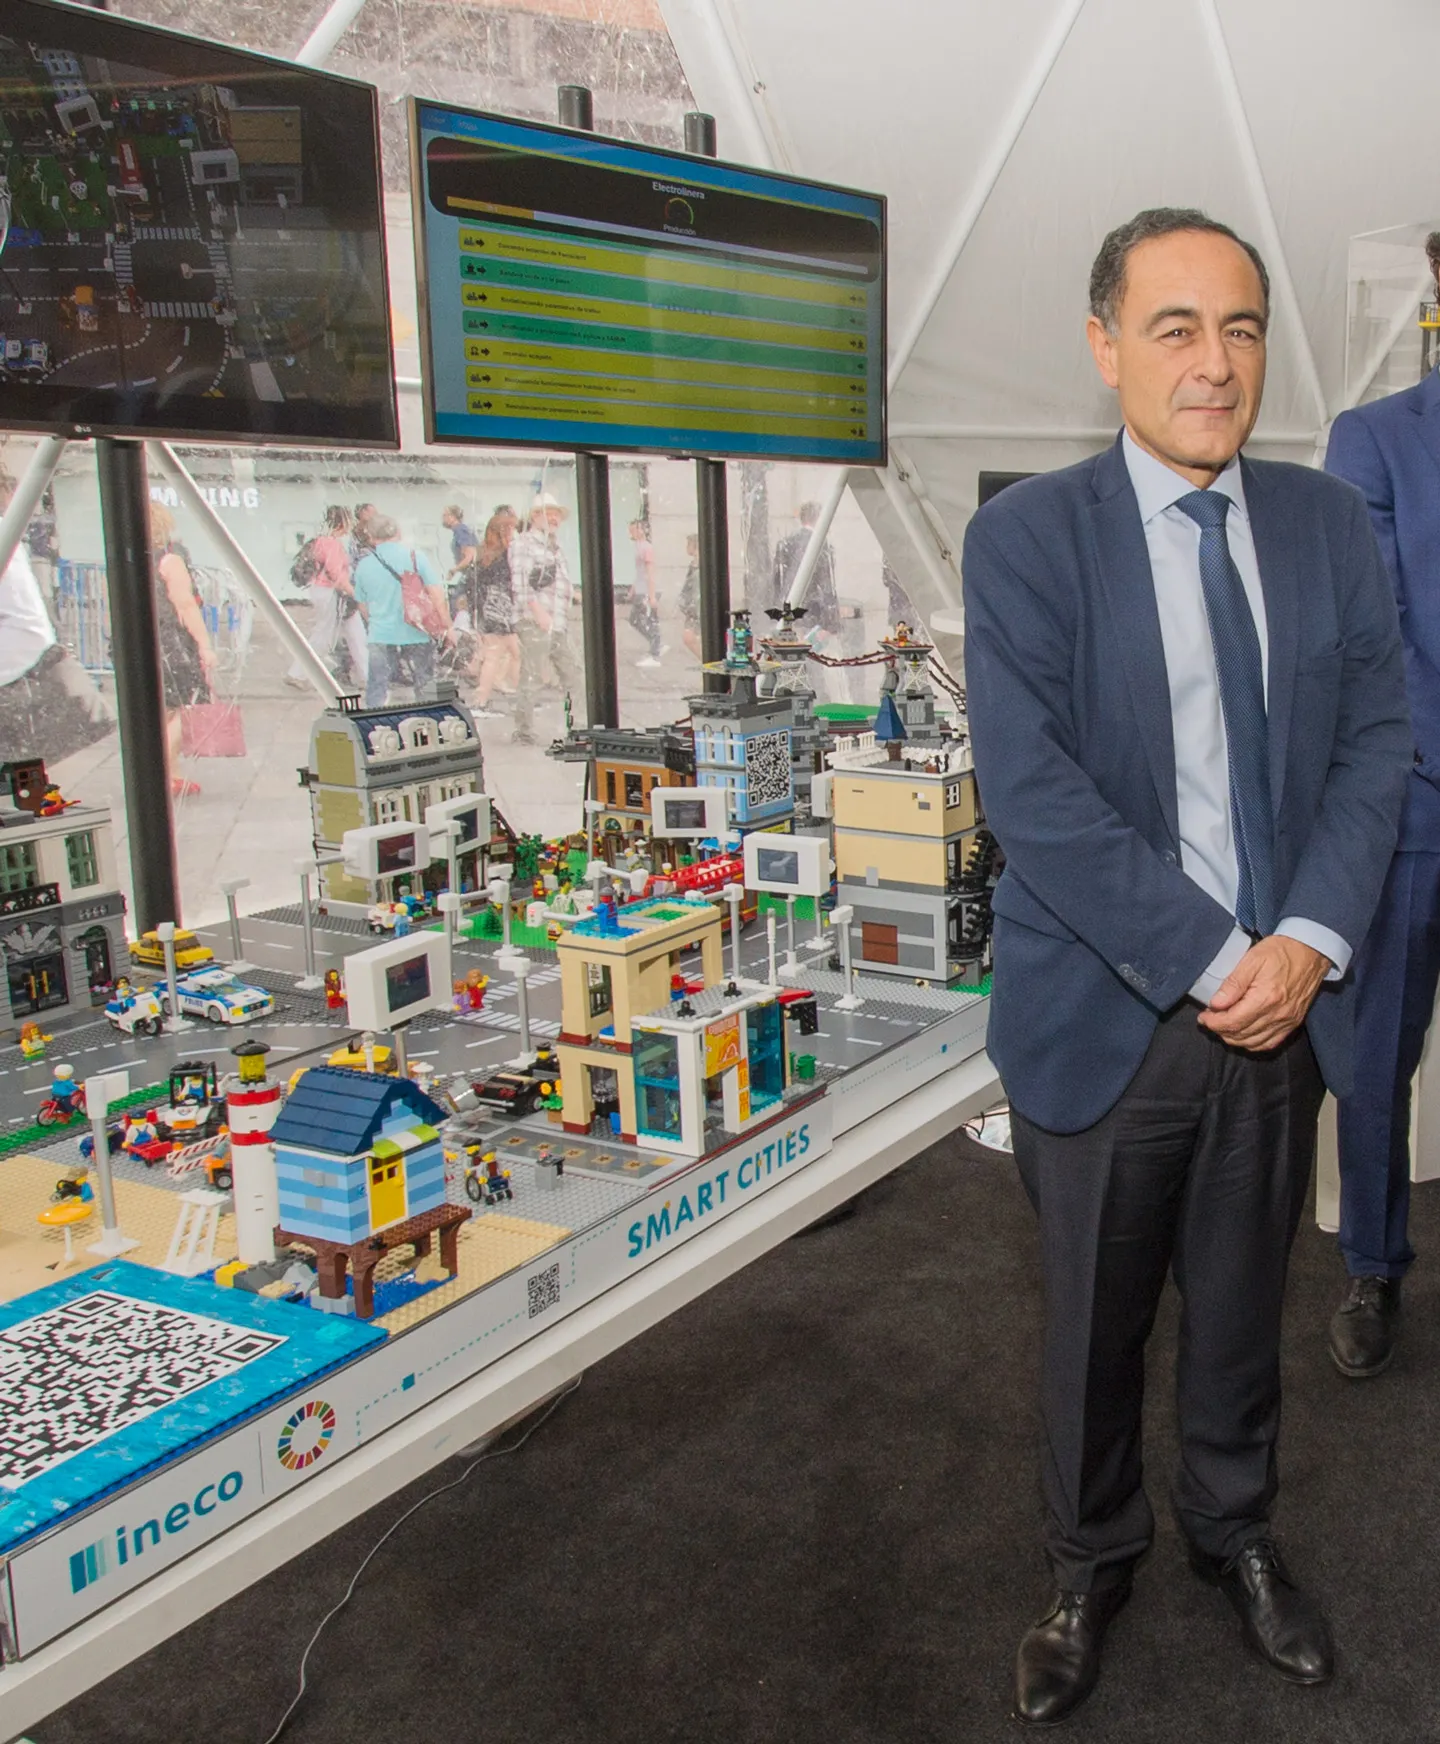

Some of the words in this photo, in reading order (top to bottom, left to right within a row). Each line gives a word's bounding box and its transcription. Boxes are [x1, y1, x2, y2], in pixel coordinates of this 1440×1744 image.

[652, 181, 705, 200] Electrolinera
[628, 1170, 730, 1258] SMART
[737, 1123, 810, 1190] CITIES
[116, 1470, 244, 1566] ineco
